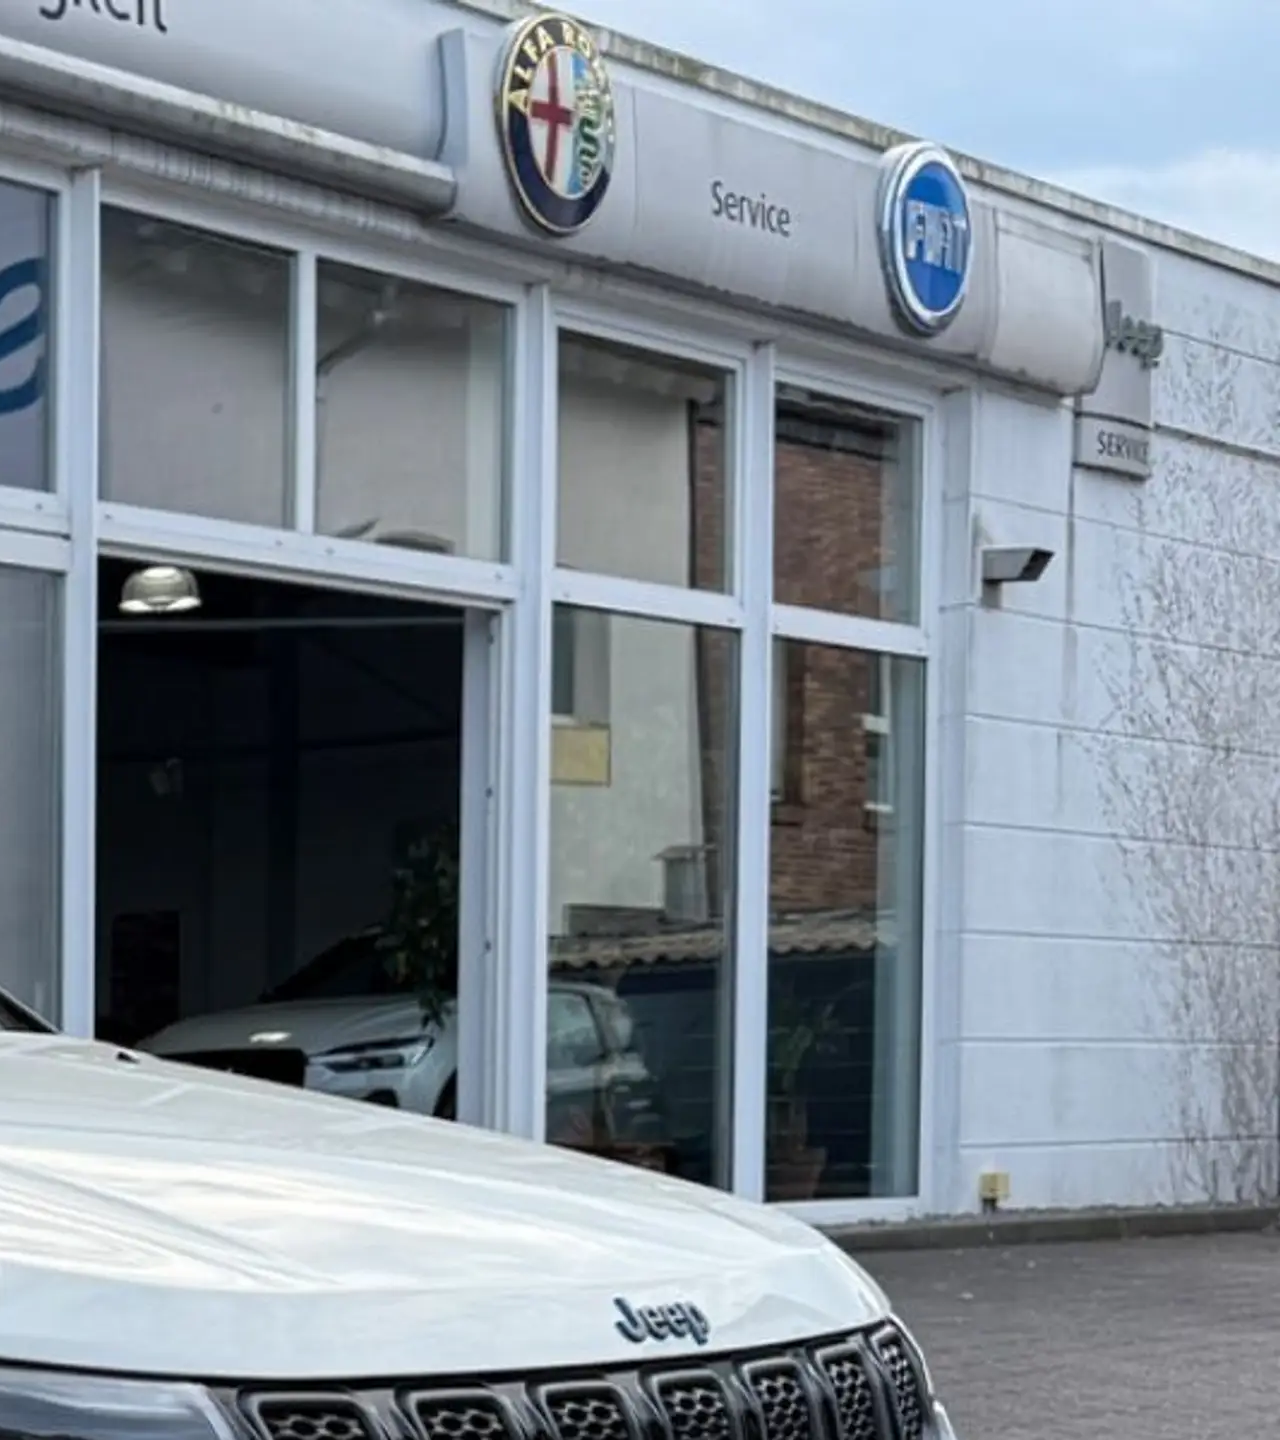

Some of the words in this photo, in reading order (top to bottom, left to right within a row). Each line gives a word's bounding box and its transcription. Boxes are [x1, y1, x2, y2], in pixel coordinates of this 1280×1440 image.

[508, 25, 556, 116] ALFA
[711, 180, 791, 238] Service
[904, 199, 968, 274] FIAT
[612, 1297, 711, 1346] Jeep
